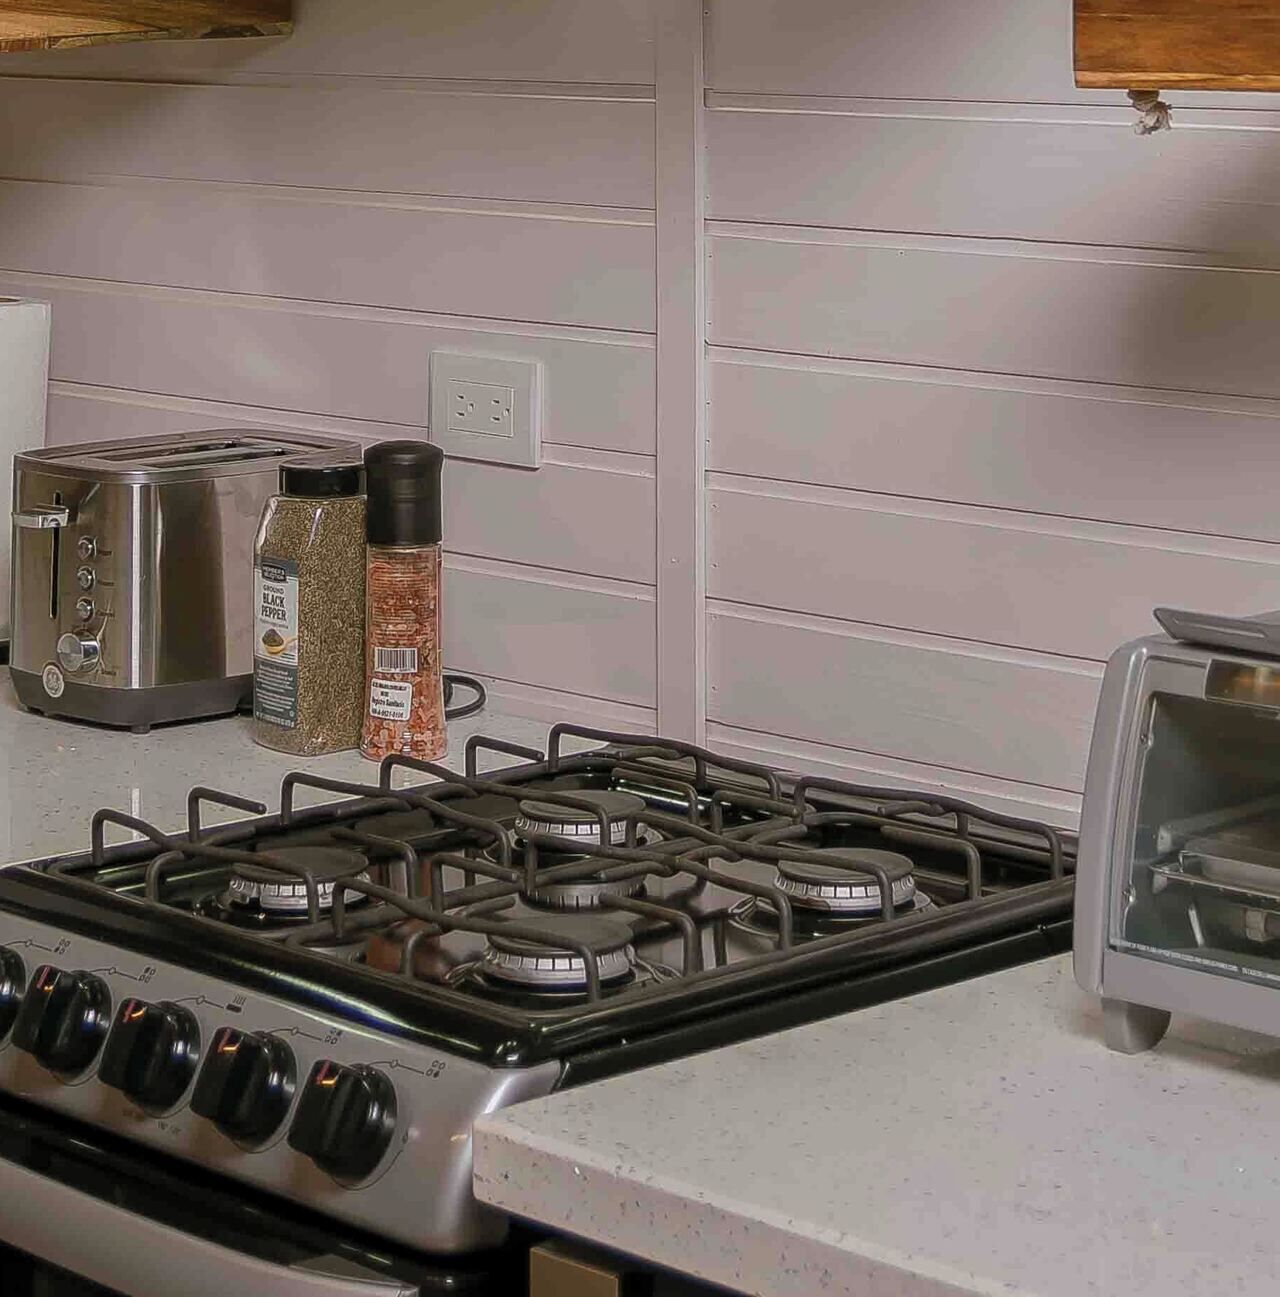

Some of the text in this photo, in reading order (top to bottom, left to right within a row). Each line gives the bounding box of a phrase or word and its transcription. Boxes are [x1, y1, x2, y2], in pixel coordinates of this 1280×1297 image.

[263, 584, 285, 595] GROUND
[262, 592, 285, 608] BLACK
[261, 604, 287, 621] PEPPER
